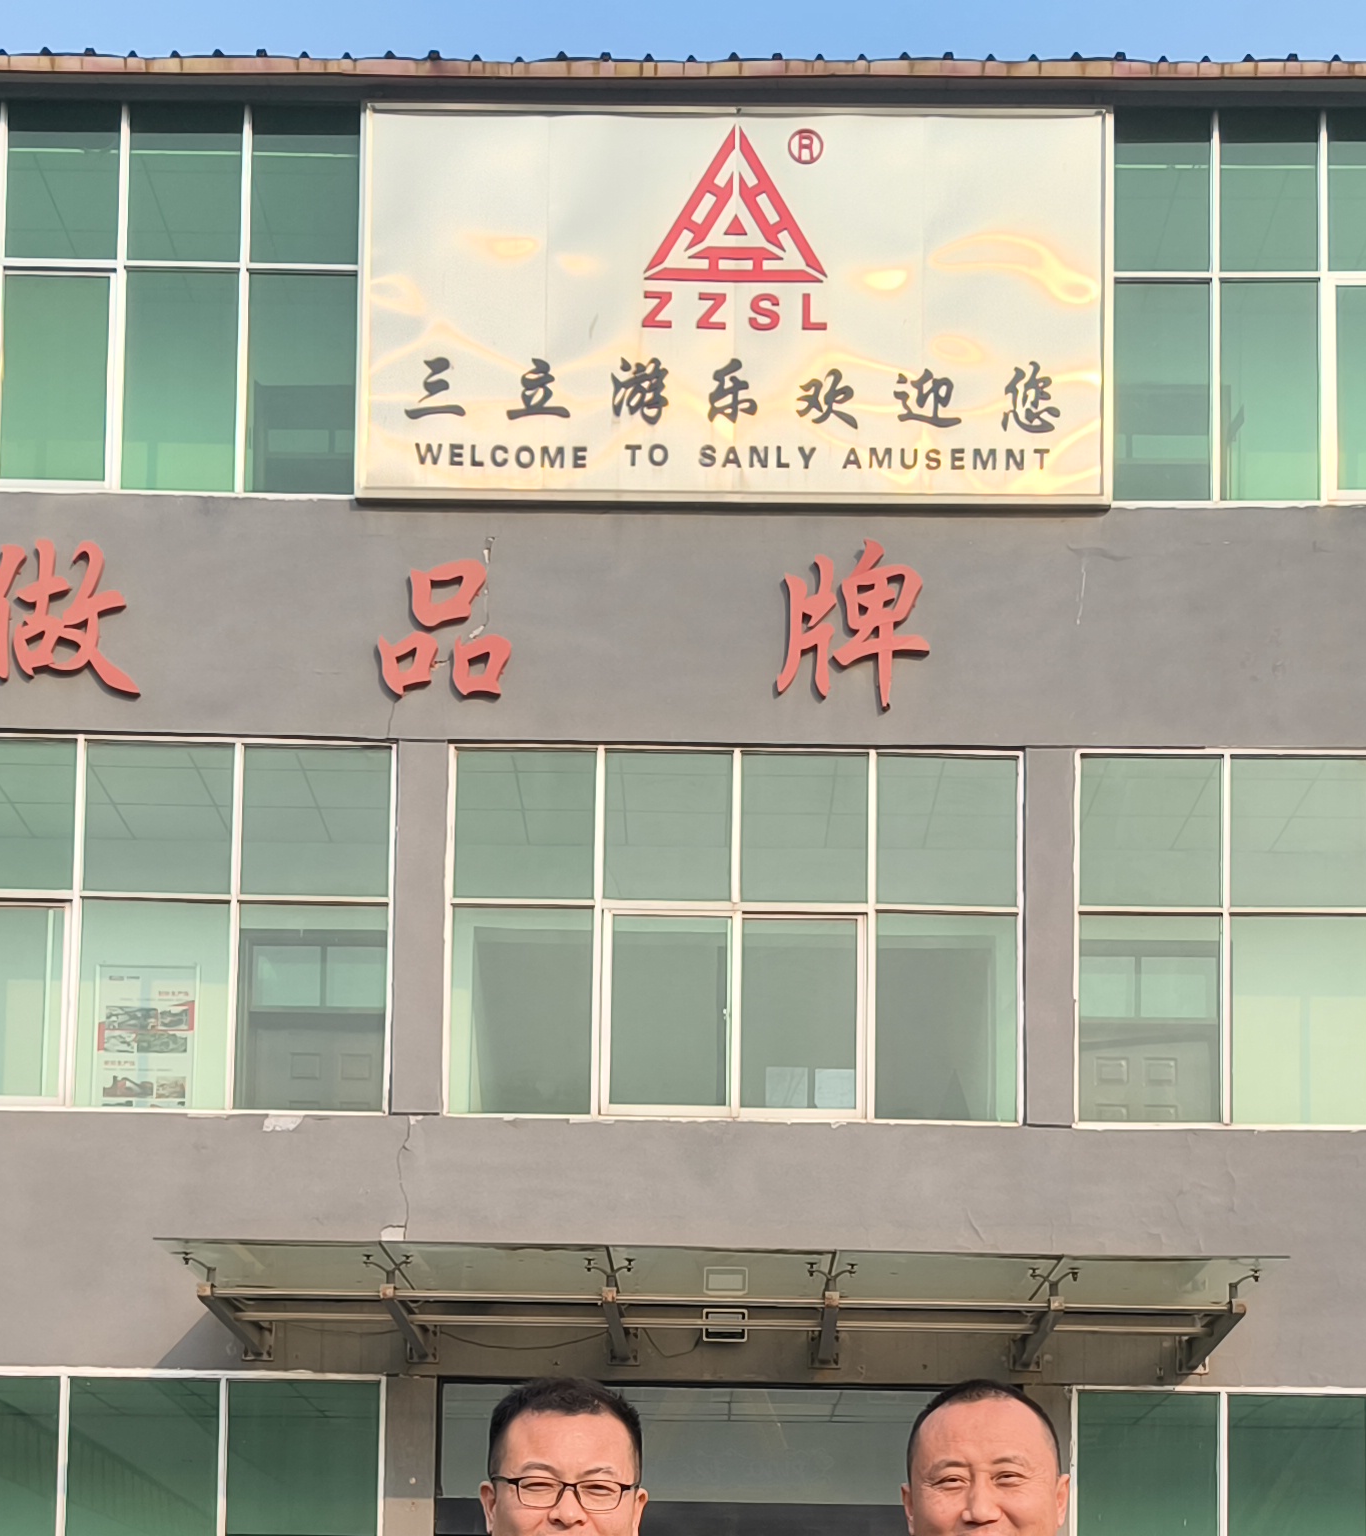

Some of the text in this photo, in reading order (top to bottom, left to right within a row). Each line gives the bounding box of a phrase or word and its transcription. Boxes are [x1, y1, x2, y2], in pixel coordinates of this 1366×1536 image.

[641, 290, 828, 331] ZZSL
[404, 356, 1061, 433] 三立游乐欢迎您
[415, 443, 1051, 471] WELCOME TO SANLY AMUSEMNT
